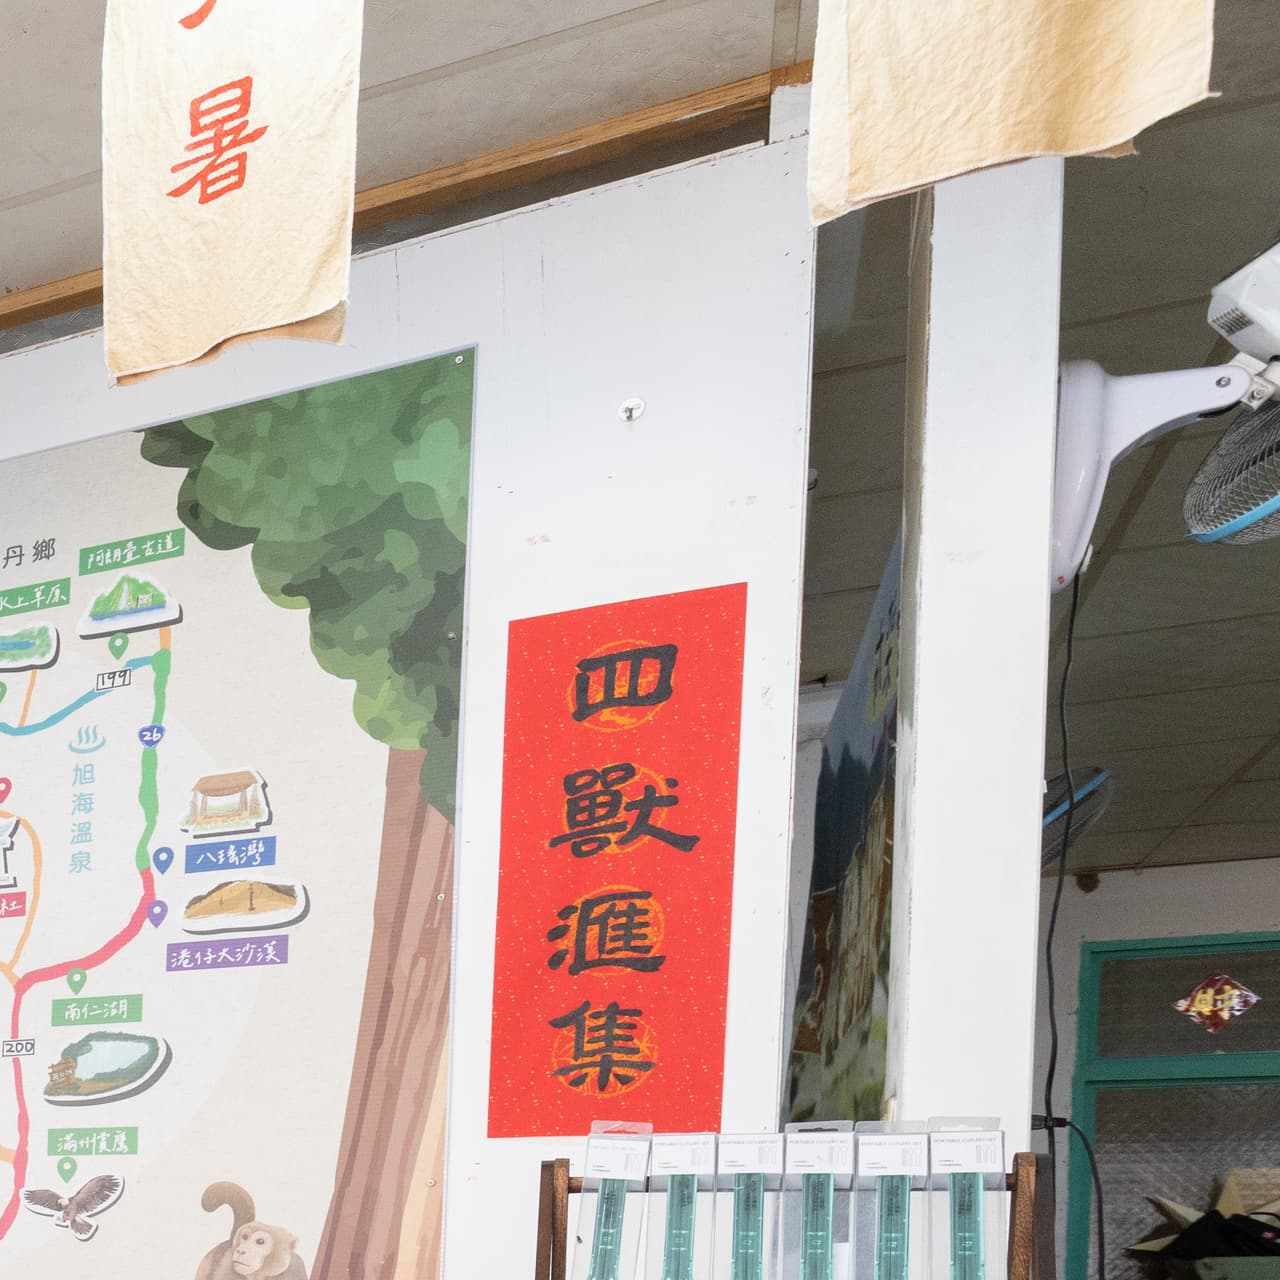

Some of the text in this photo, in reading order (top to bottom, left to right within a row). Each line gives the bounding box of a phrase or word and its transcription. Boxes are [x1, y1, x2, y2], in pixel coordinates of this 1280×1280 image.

[100, 671, 128, 688] 199
[142, 728, 162, 742] 26
[68, 763, 96, 873] 旭海溫泉
[171, 940, 282, 968] 港仔大沙漠
[64, 999, 129, 1021] 南仁湖
[4, 1040, 35, 1055] 200
